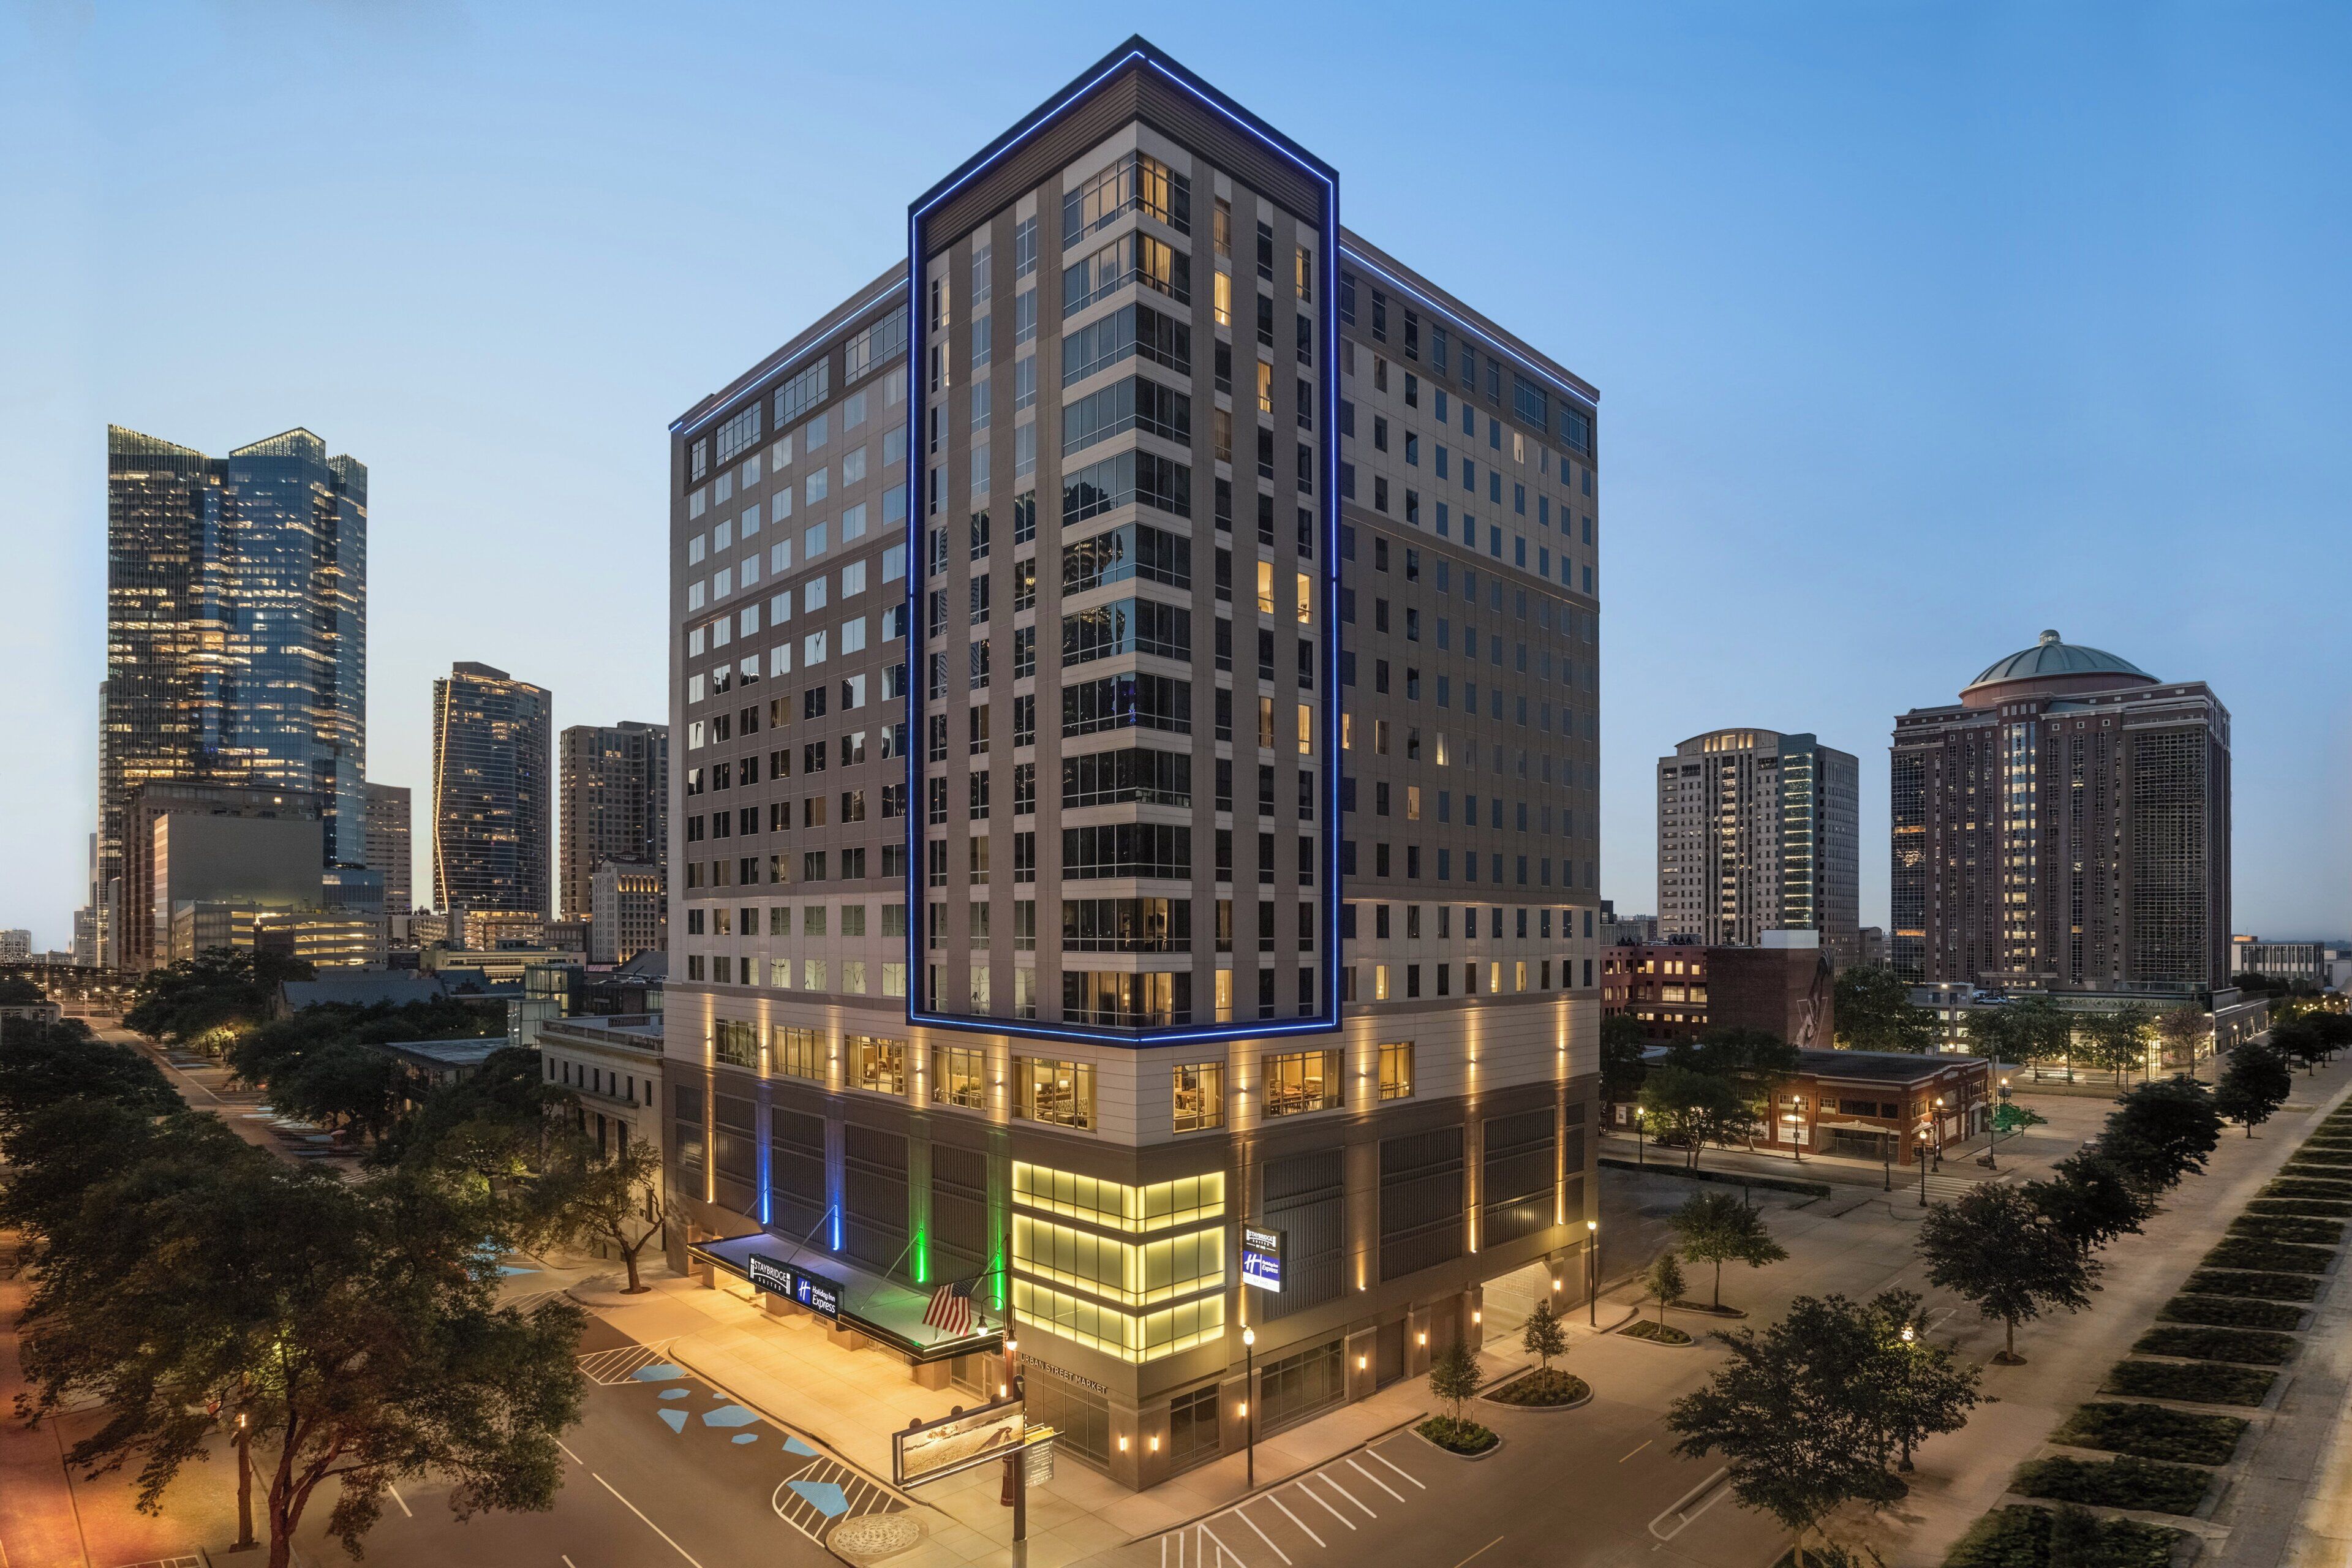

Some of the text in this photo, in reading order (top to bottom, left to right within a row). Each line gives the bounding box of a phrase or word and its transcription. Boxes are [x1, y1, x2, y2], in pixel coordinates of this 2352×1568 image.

[1249, 1231, 1273, 1242] STAYBRIDGE
[754, 1260, 786, 1283] STAYBRIDGE
[1262, 1264, 1278, 1274] Express
[758, 1276, 781, 1291] SUITES
[812, 1286, 829, 1302] Holiday
[812, 1294, 836, 1313] Express
[1020, 1353, 1107, 1394] URBAN STREET MARKET
